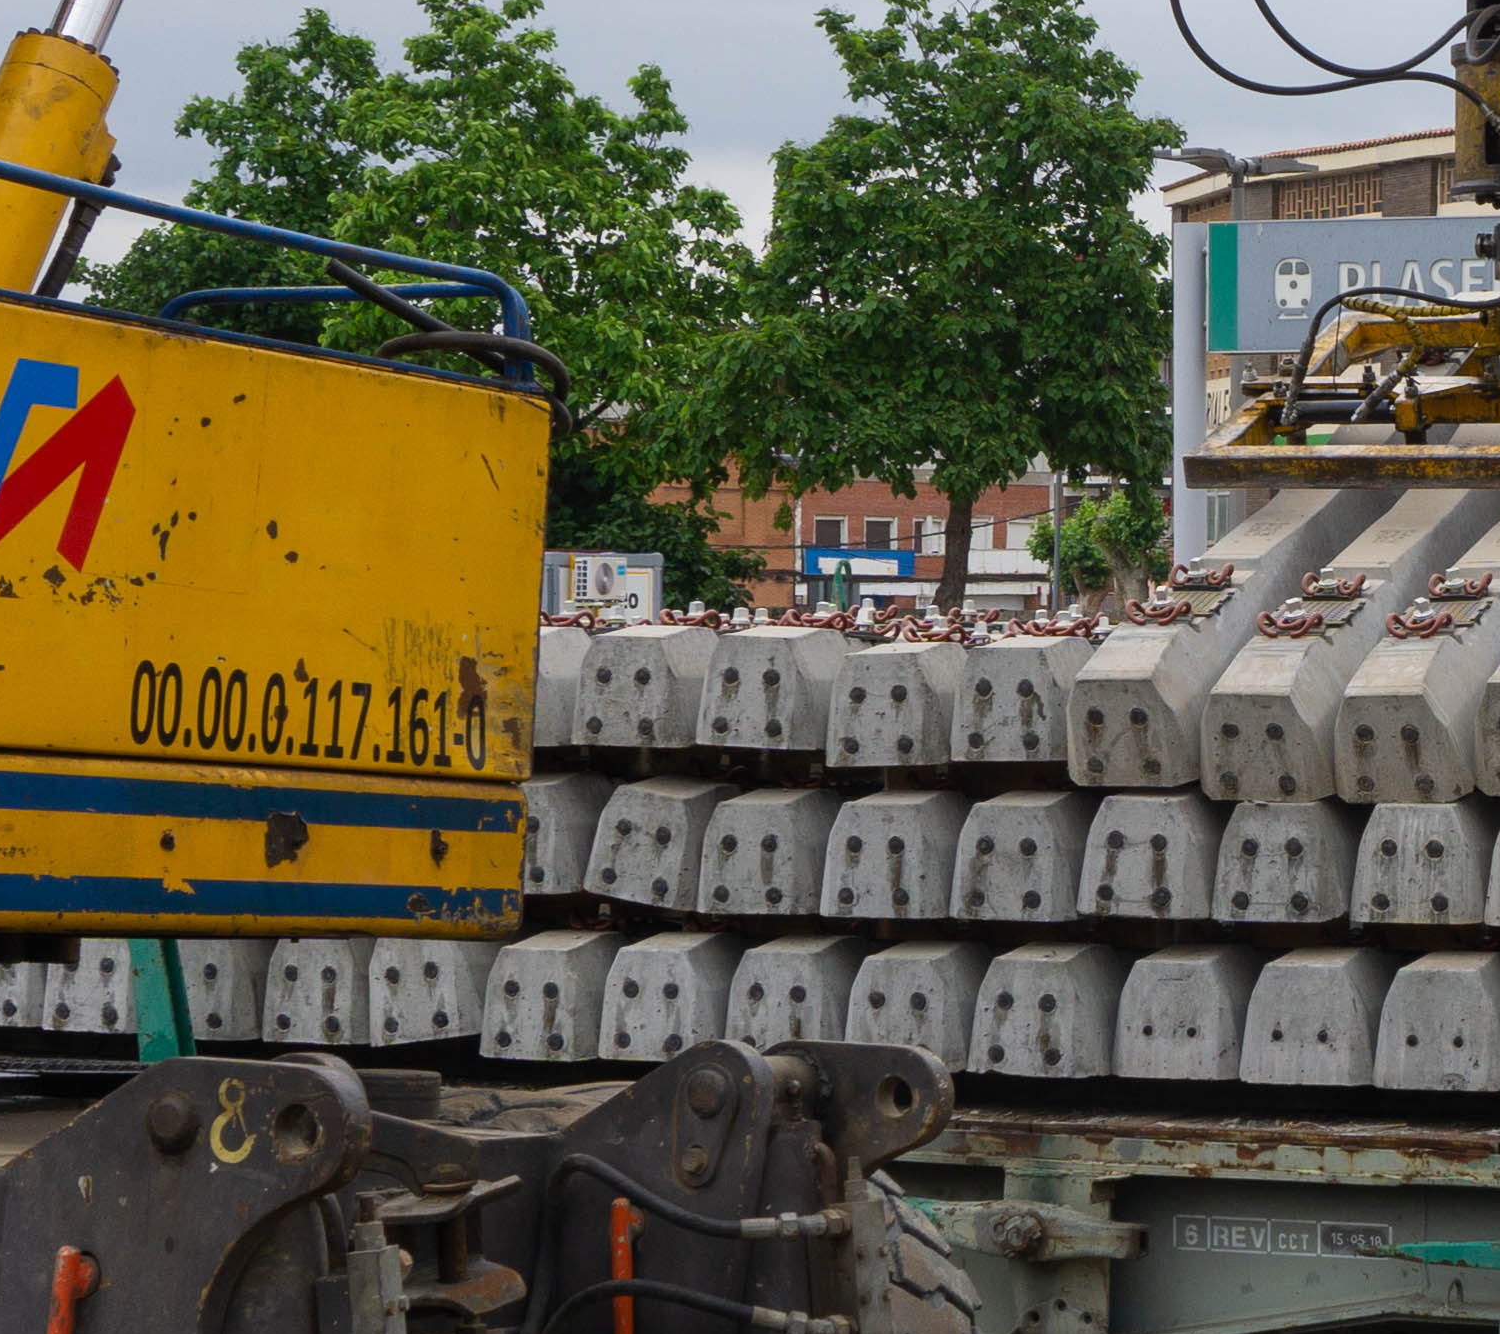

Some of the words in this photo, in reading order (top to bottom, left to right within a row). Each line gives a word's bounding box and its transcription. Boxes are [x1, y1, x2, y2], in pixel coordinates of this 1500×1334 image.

[131, 660, 485, 771] 00.00.0.117.161-0
[1184, 1223, 1198, 1245] 6
[1213, 1226, 1266, 1249] REV
[1278, 1233, 1309, 1251] CCT
